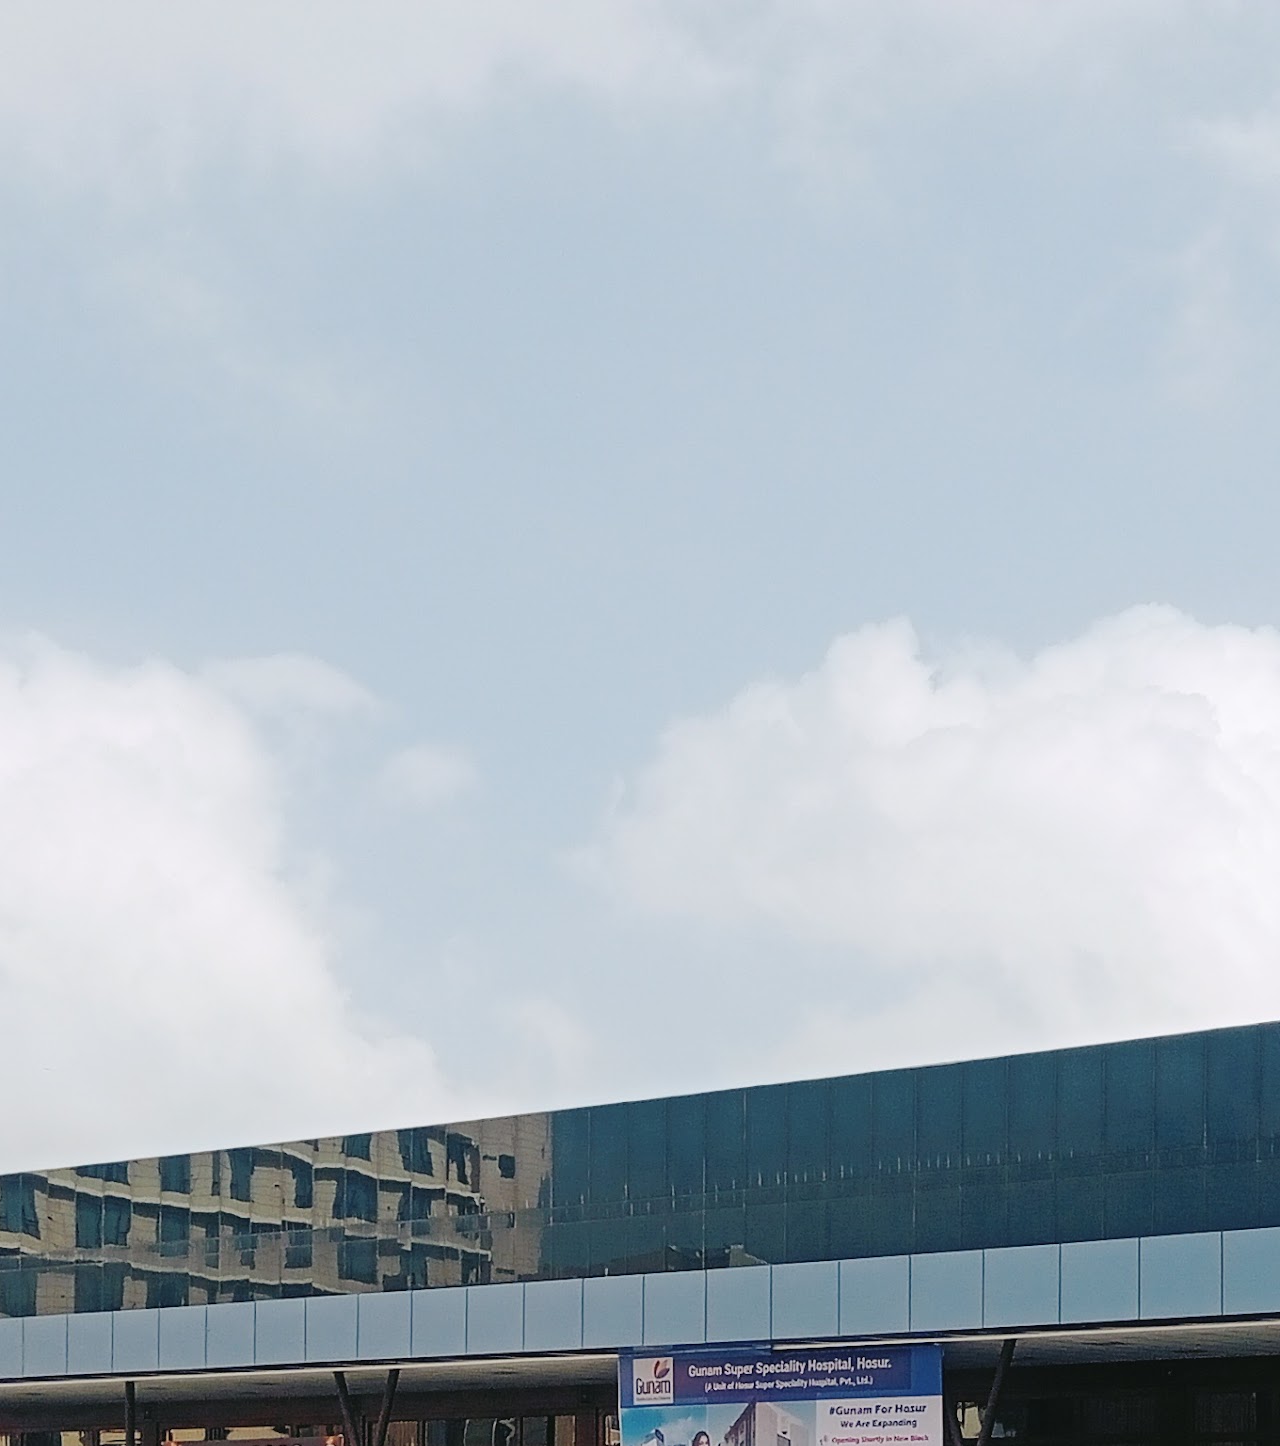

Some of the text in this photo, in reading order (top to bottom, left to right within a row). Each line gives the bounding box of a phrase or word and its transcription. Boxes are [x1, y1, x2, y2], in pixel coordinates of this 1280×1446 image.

[688, 1356, 892, 1379] Gunam Super Speciality Hospital, Hosur.
[636, 1377, 671, 1395] Gunam
[829, 1404, 926, 1415] #Gunam For Hosur
[840, 1420, 853, 1428] We
[872, 1418, 917, 1428] Expanding
